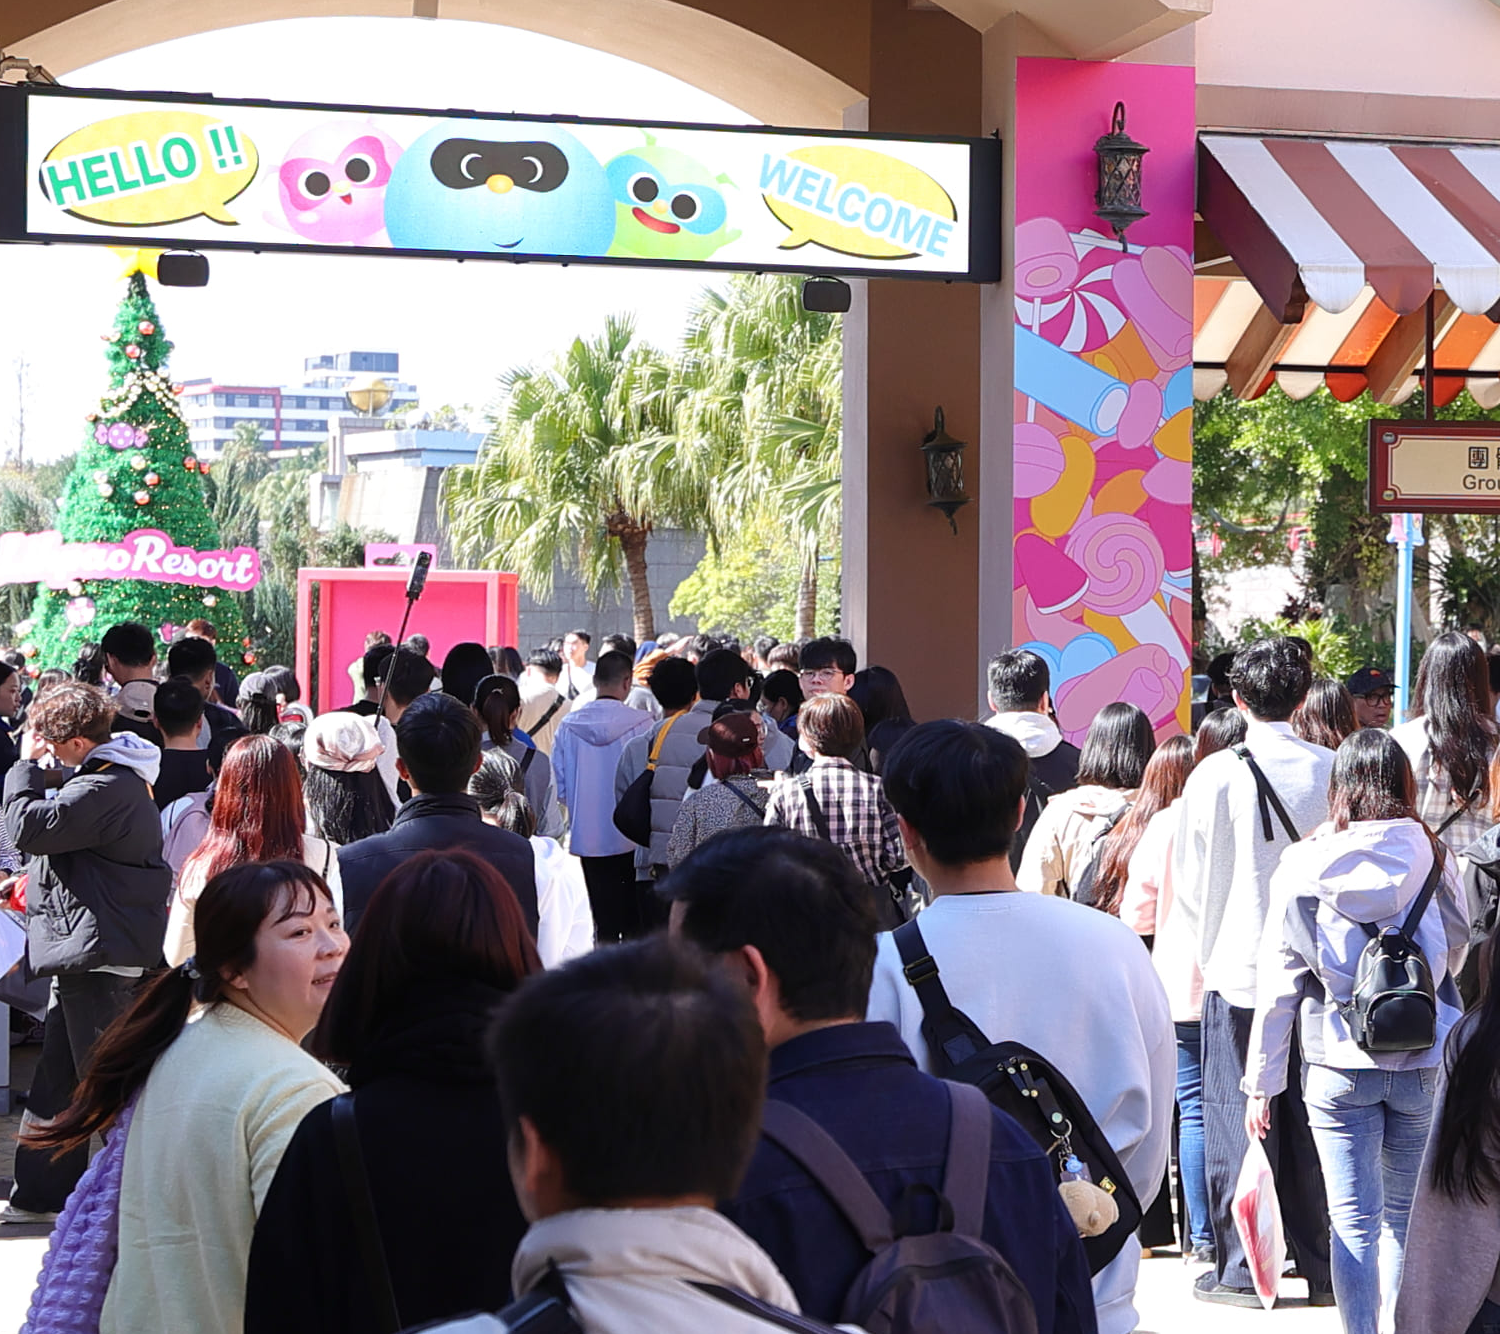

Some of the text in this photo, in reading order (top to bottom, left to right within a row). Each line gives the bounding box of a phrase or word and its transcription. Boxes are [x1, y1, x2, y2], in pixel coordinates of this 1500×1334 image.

[46, 136, 197, 206] HELLO
[759, 153, 954, 258] WELCOME
[131, 534, 254, 585] Resort
